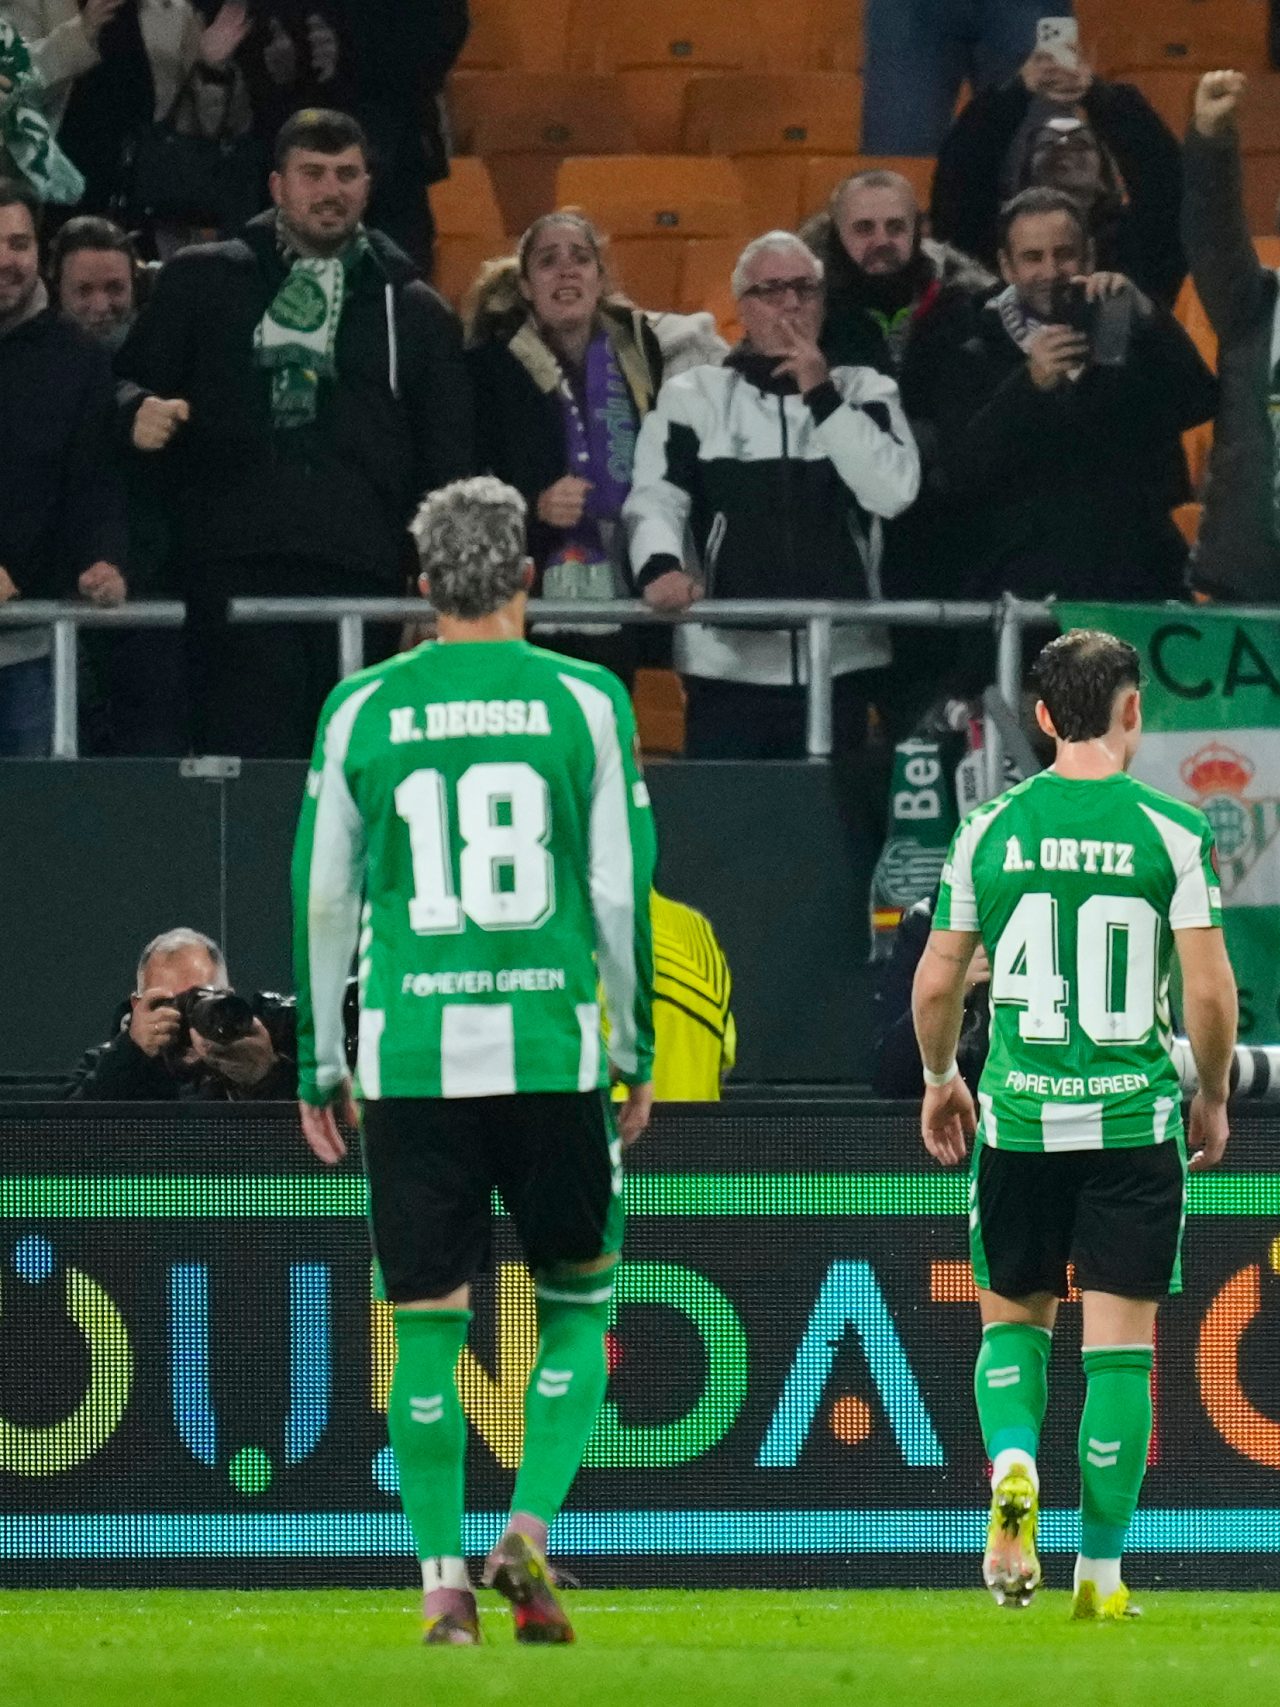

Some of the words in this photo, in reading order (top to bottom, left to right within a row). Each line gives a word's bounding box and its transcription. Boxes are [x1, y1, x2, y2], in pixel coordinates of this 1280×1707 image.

[388, 706, 424, 745] N.
[425, 699, 552, 741] DEOSSA
[393, 761, 557, 936] 18
[1003, 835, 1036, 872] A.
[1039, 837, 1136, 878] ORTIZ
[402, 971, 494, 997] FOREVER
[496, 968, 566, 993] GREEN
[992, 892, 1162, 1047] 40
[1005, 1070, 1085, 1097] FOREVER
[1087, 1072, 1150, 1096] GREEN
